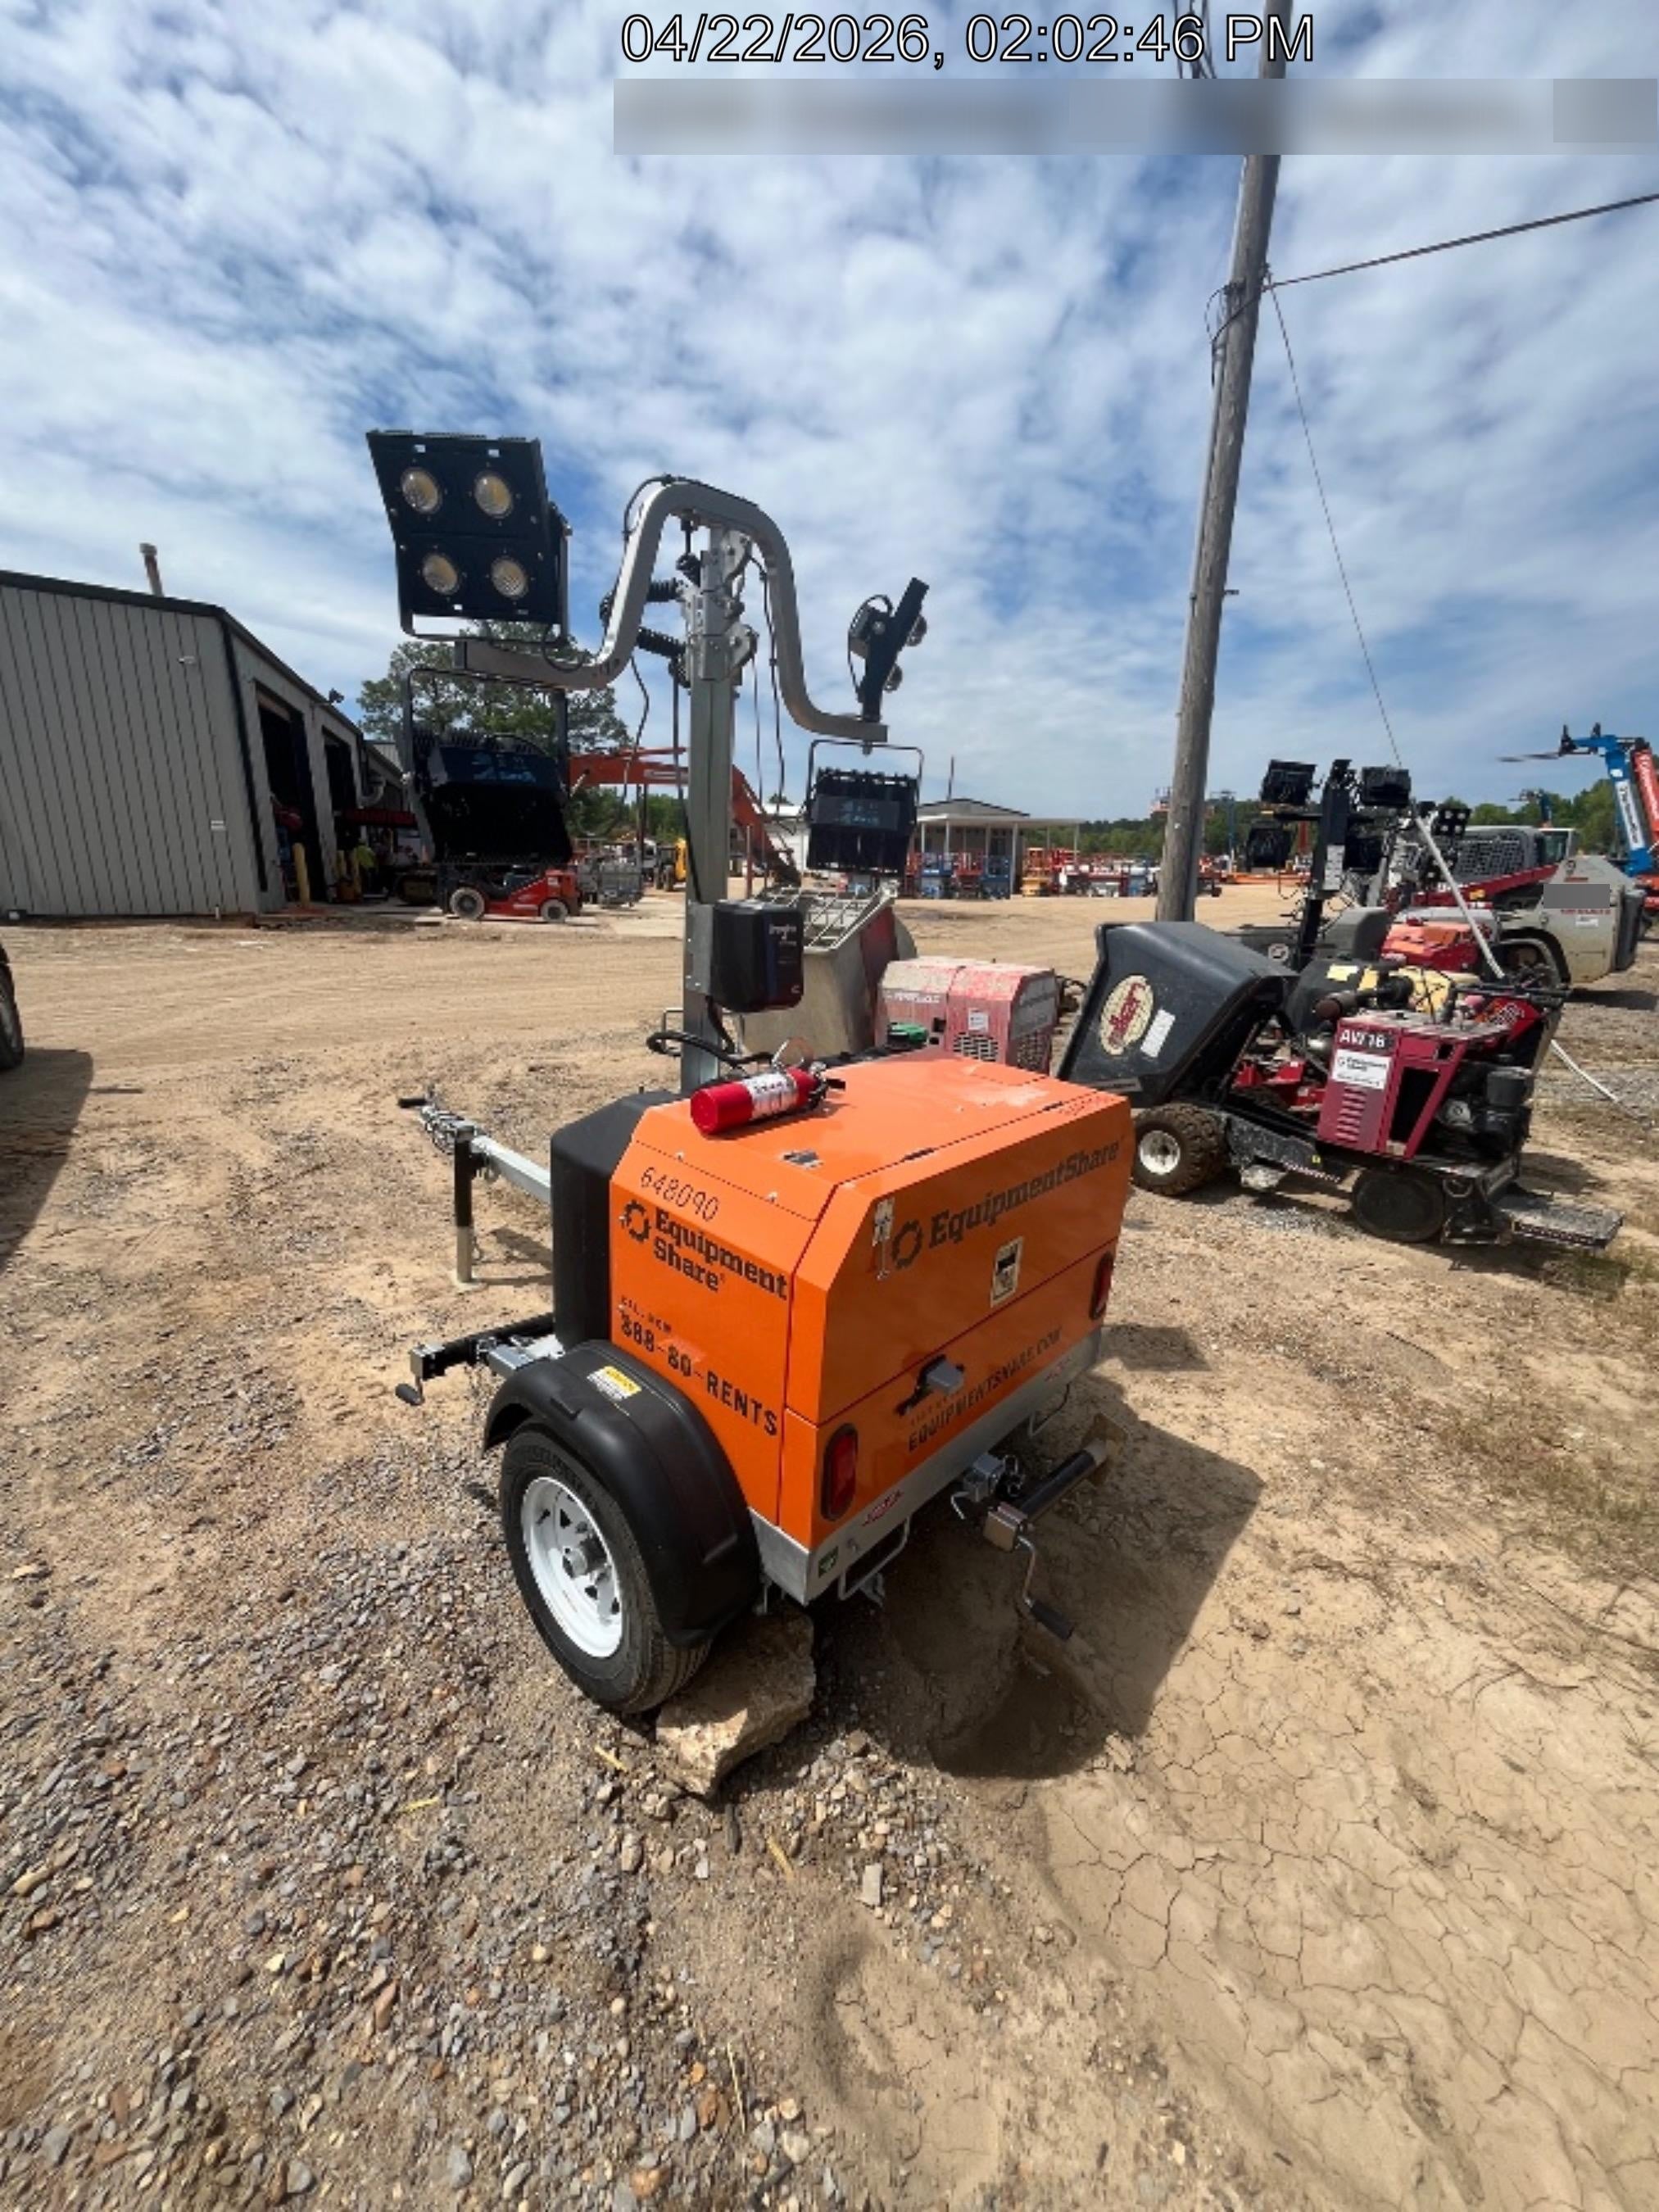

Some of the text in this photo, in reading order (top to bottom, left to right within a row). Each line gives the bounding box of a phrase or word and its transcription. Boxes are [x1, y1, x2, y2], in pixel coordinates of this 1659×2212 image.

[641, 1167, 718, 1222] 648090
[929, 1140, 1120, 1249] EquipmentShare
[654, 1235, 718, 1293] Share
[656, 1207, 787, 1300] Equipment
[621, 1310, 777, 1435] 888-80-RENTS
